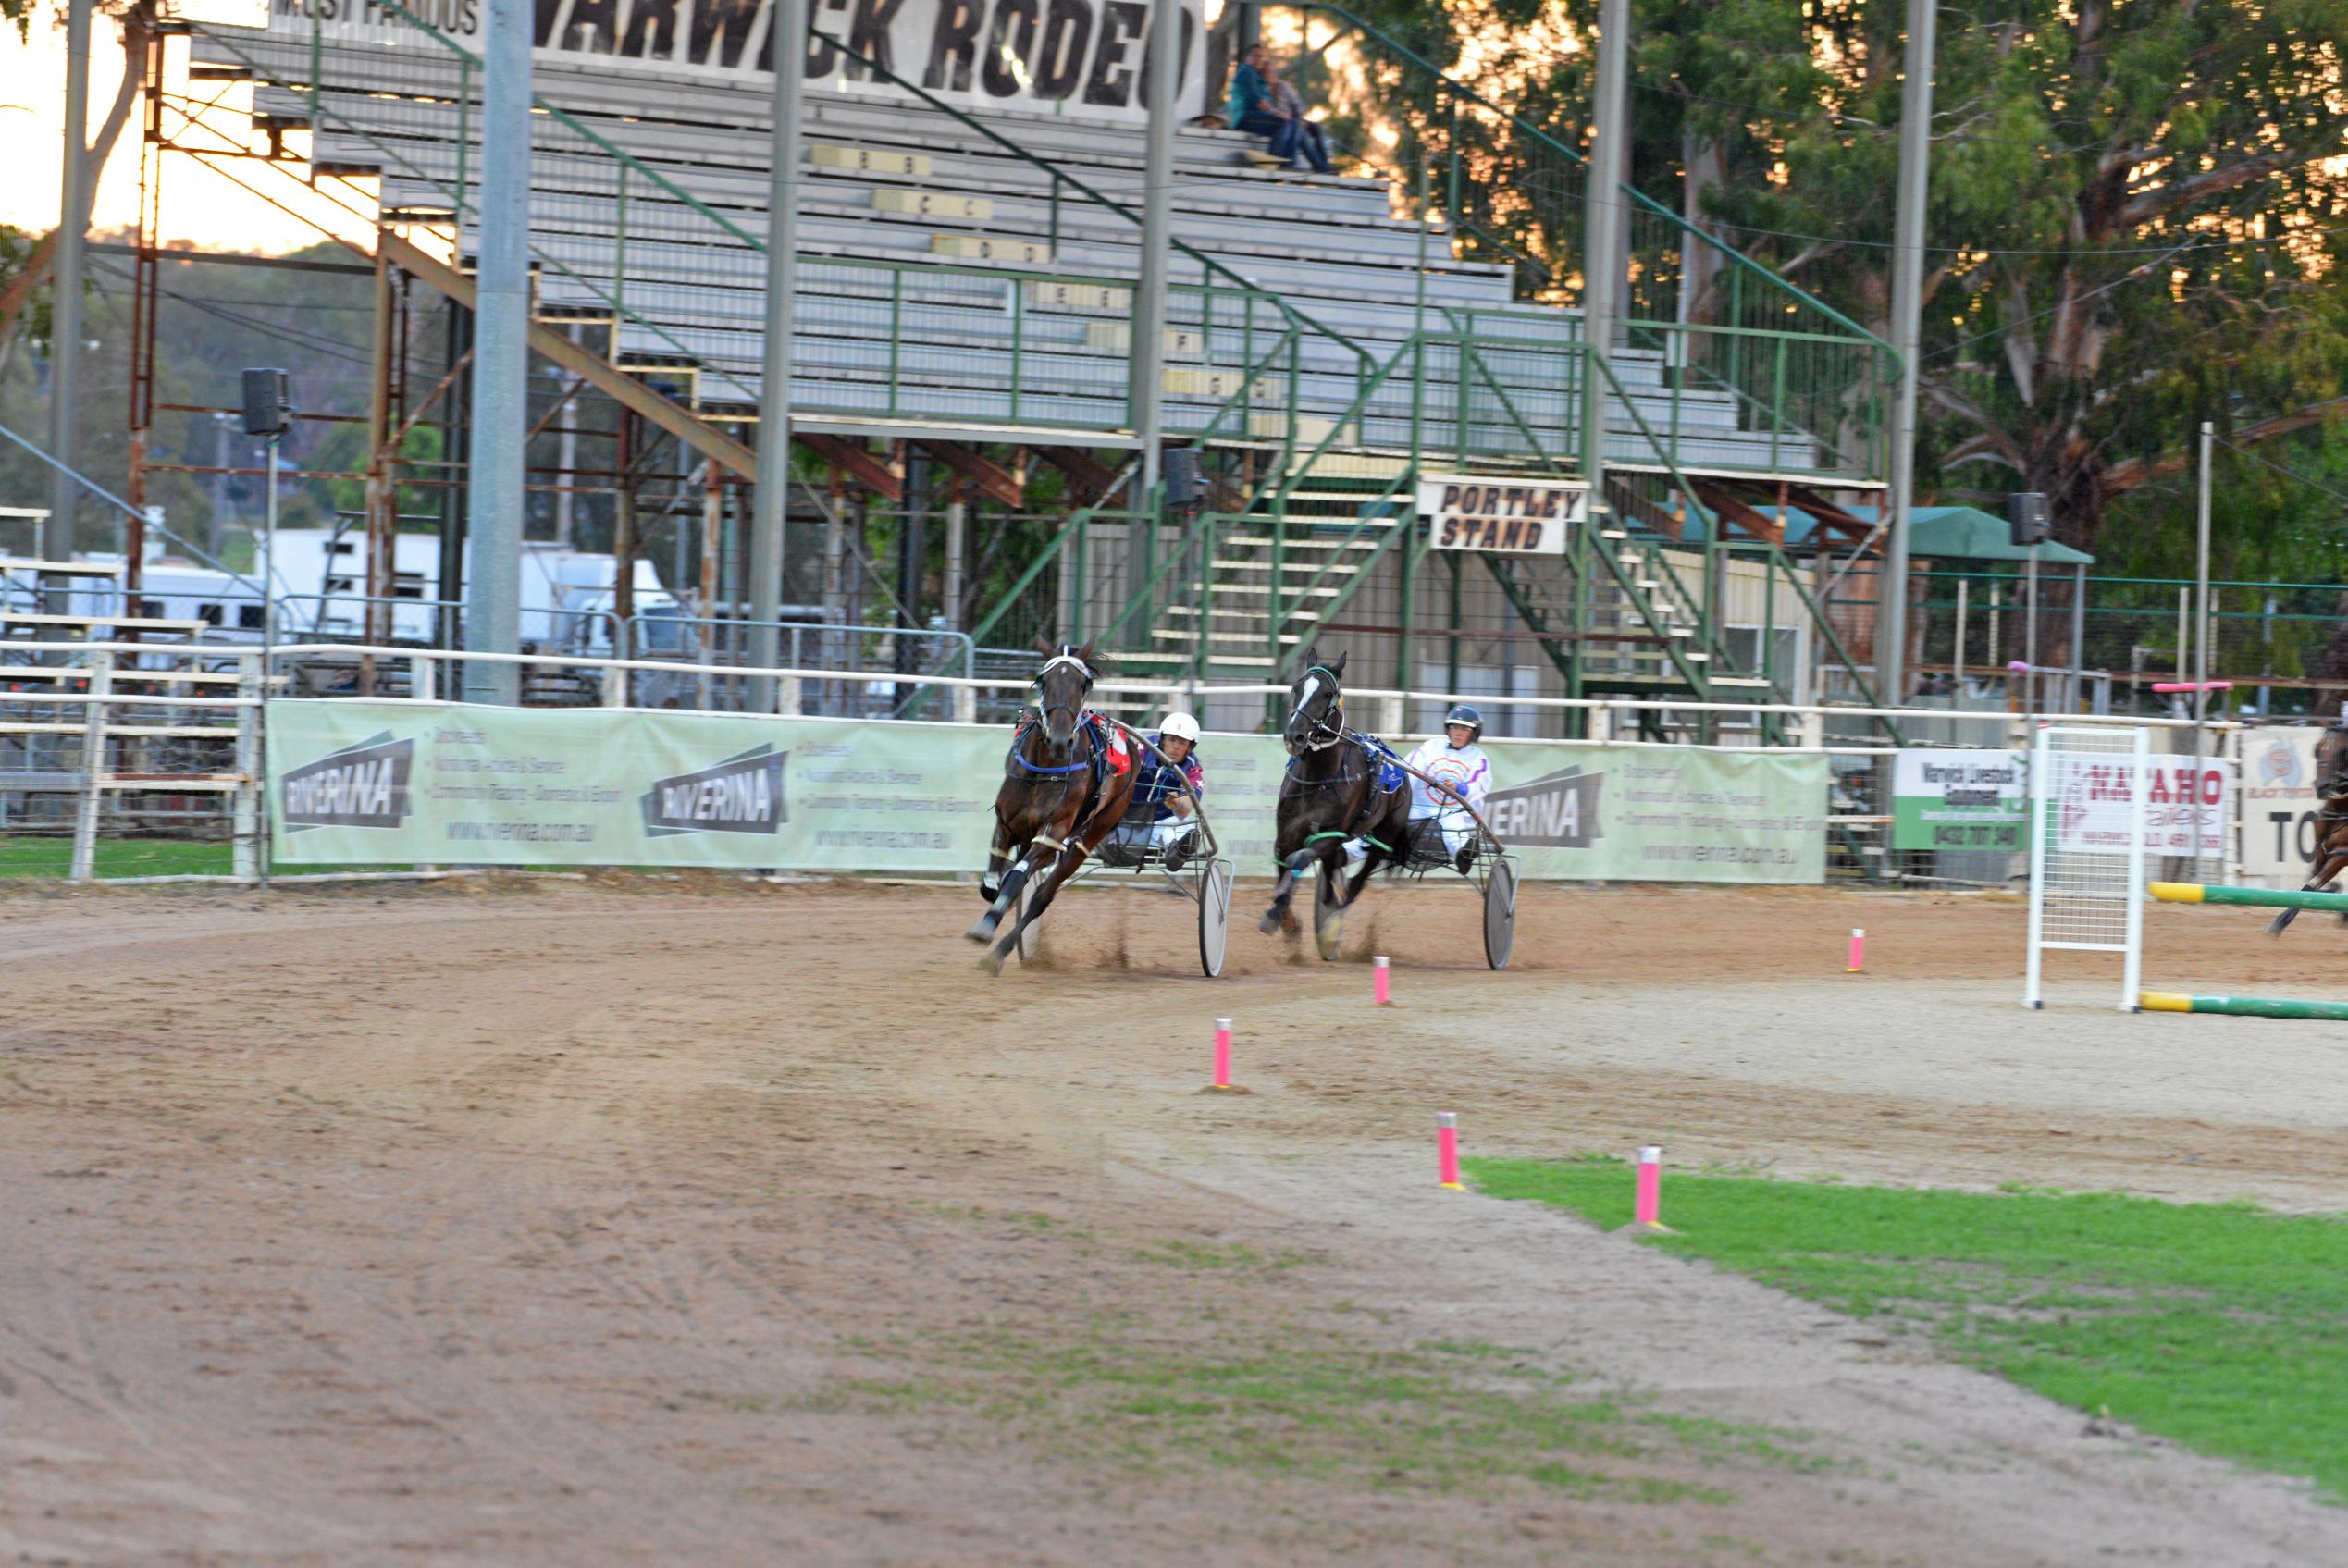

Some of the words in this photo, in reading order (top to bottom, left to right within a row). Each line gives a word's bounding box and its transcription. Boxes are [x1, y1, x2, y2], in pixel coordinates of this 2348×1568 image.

[535, 0, 910, 84] RWCK
[923, 0, 1195, 110] RODEO
[1440, 485, 1581, 518] PORTLEY
[1440, 517, 1543, 550] STAND
[286, 757, 394, 814] RIVERINA
[661, 768, 772, 821] RIVERINA
[2089, 765, 2221, 805] NAAHO
[1483, 789, 1580, 837] ERINA
